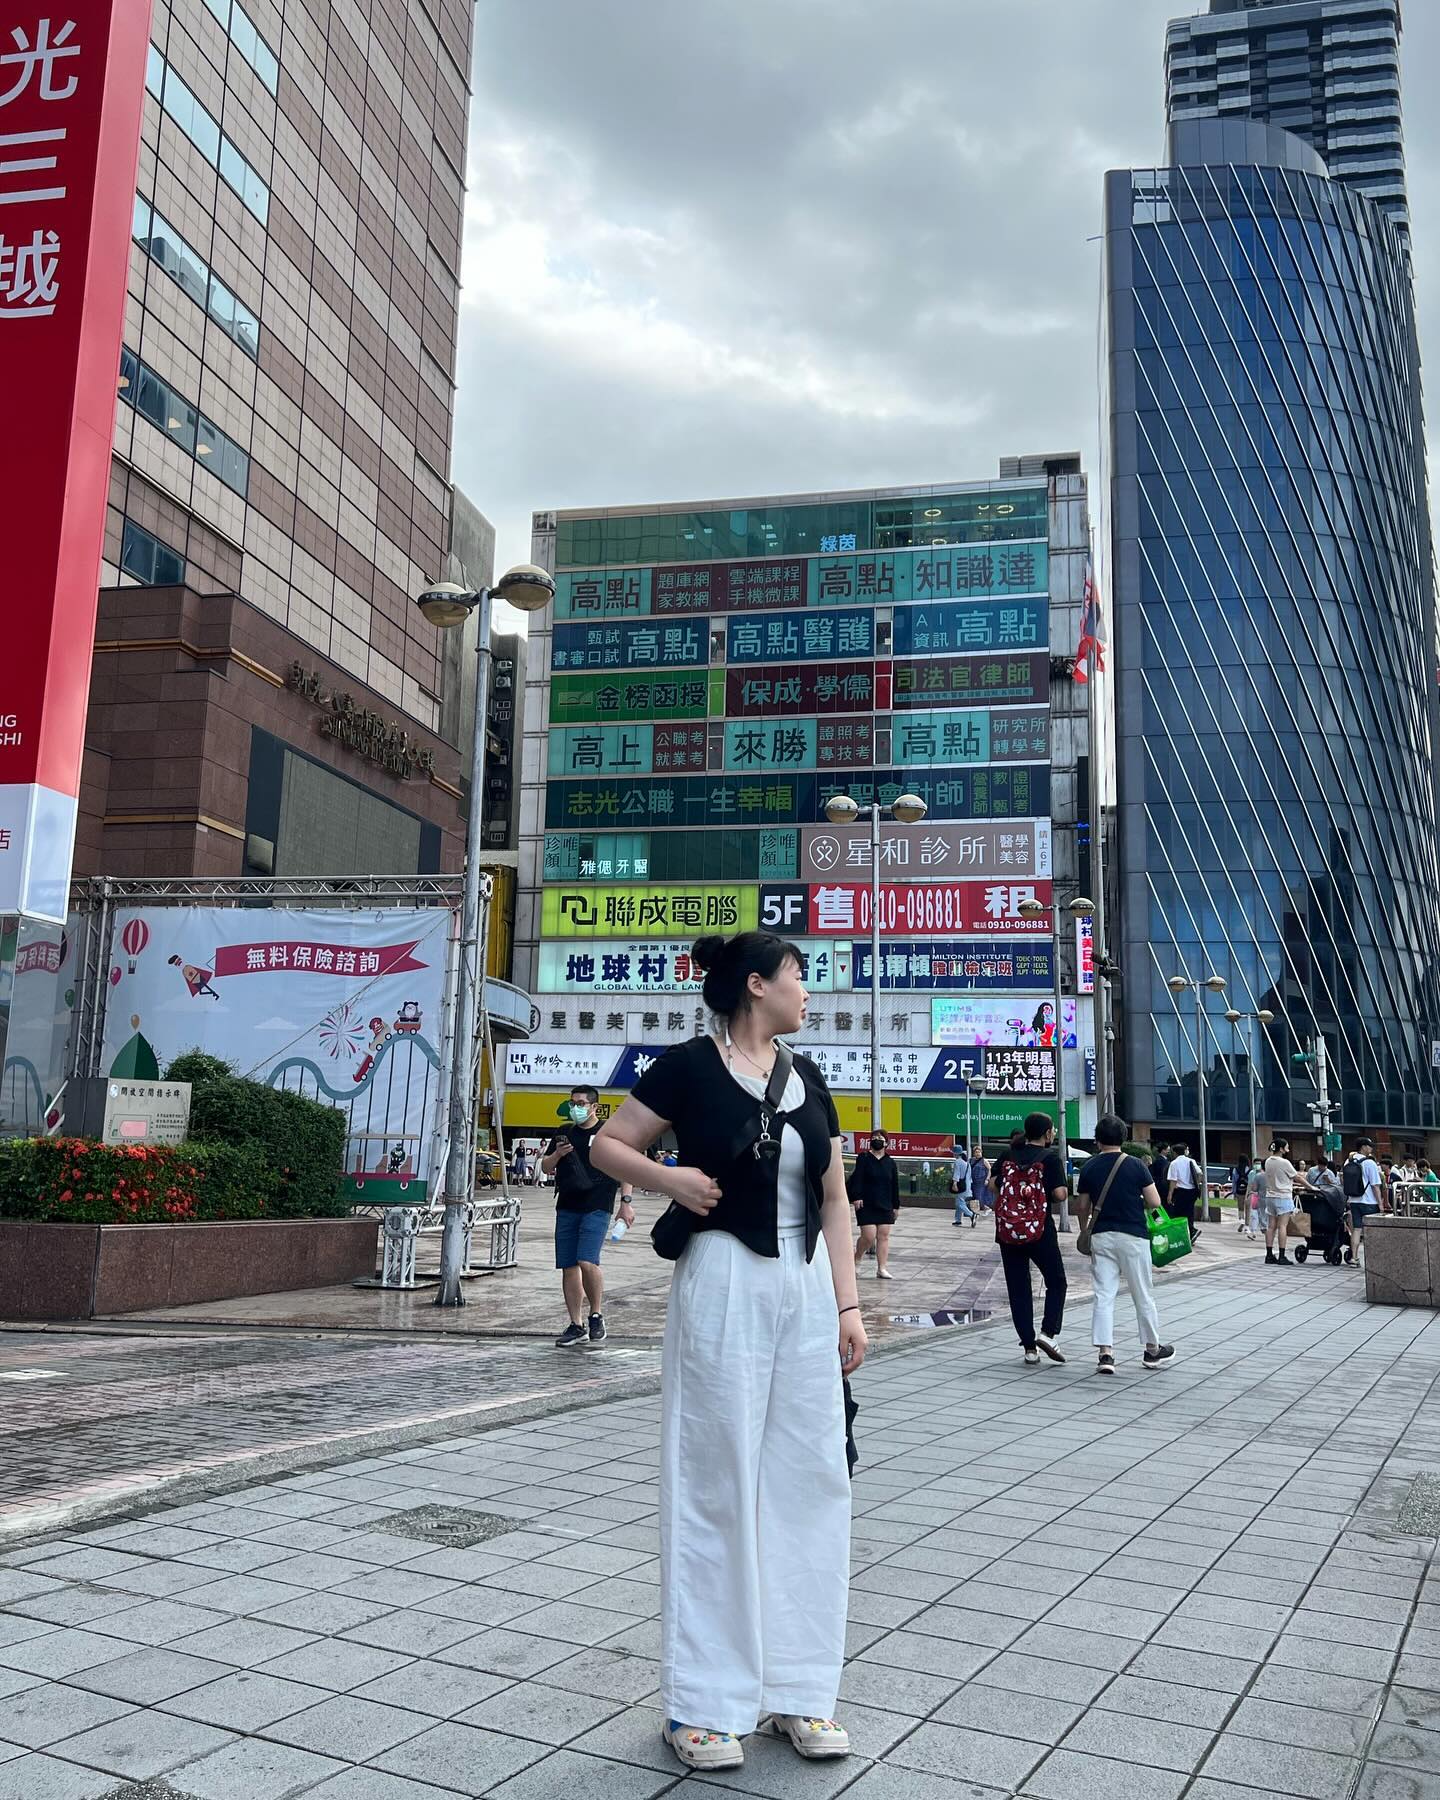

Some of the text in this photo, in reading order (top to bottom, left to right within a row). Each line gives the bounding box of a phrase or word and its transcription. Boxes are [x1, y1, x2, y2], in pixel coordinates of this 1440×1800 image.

[571, 577, 640, 612] 高點
[587, 628, 620, 645] 甄試
[733, 615, 871, 657] 高點醫護
[956, 607, 1037, 646] 高點
[627, 628, 699, 663] 高點
[914, 632, 949, 649] 資訊
[553, 649, 620, 666] 書審口試
[596, 681, 706, 711] 金榜函授
[819, 725, 870, 740] 證照考
[993, 716, 1046, 733] 研究所
[656, 731, 704, 747] 公職考
[732, 729, 808, 763] 來勝
[902, 721, 981, 758] 高點
[993, 737, 1046, 755] 轉學考
[572, 734, 642, 769] 高上
[655, 750, 704, 767] 就業考
[819, 745, 870, 761] 專技考
[567, 788, 675, 815] 志光公職
[683, 785, 793, 813] 一生幸福
[845, 836, 987, 866] 星和診所
[1000, 834, 1029, 848] 醫學
[1000, 850, 1029, 864] 美容
[605, 895, 738, 926] 聯成電腦
[761, 895, 803, 926] 5F
[812, 886, 962, 929] 售 010-096881
[984, 885, 1035, 918] 租
[988, 920, 1049, 929] 0910-096881
[246, 945, 380, 973] 無料保險諮詢
[816, 952, 828, 982] 4F
[986, 1051, 1052, 1065] 113年明星
[849, 1075, 918, 1083] 02-2826603
[986, 1064, 1055, 1079] 私中入考錄
[986, 1078, 1055, 1093] 取人數破百
[860, 1137, 910, 1151] 新銀行
